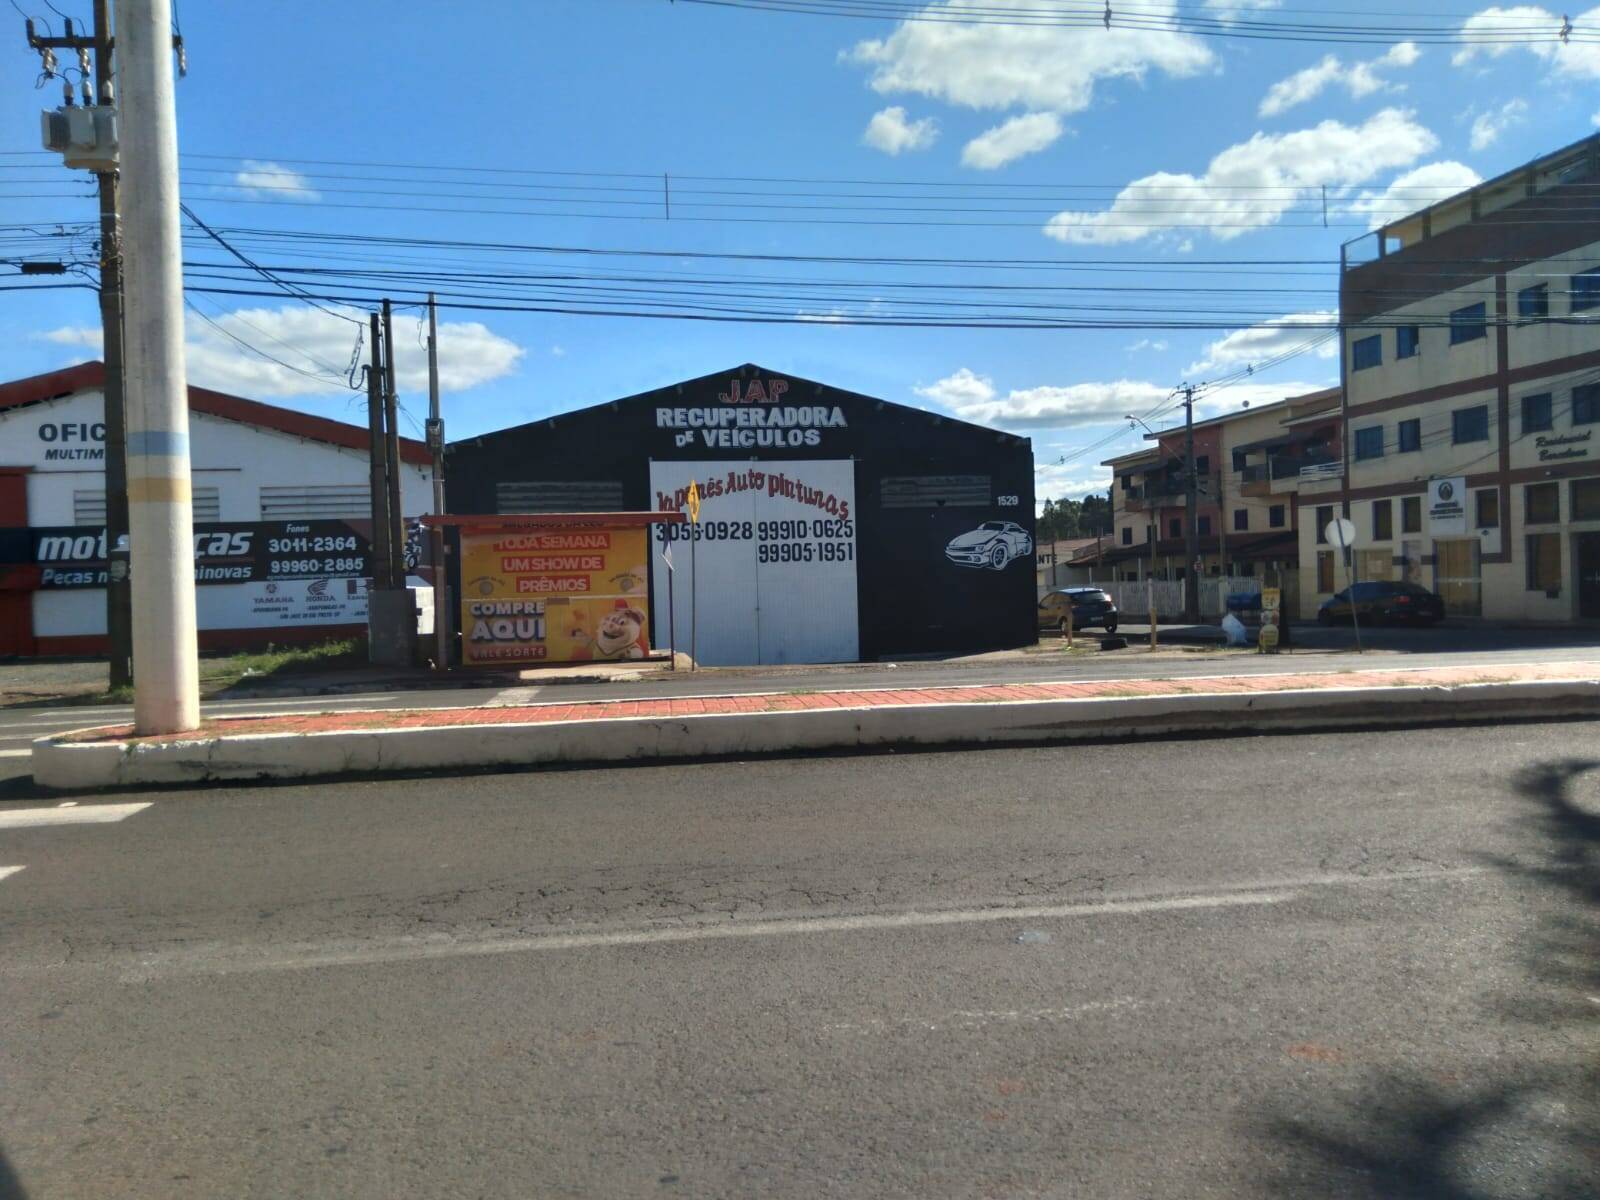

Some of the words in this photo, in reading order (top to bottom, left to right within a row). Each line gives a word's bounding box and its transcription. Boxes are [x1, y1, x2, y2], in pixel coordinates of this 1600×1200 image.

[718, 379, 789, 404] JAP
[656, 406, 848, 428] RECUPERADORA
[38, 422, 107, 442] OFIC
[675, 430, 695, 447] DE
[701, 427, 821, 447] VEÍCULOS
[45, 448, 105, 460] MULTIM
[724, 469, 765, 494] Auto
[496, 535, 541, 549] TODA
[542, 535, 608, 549] SEMANA
[503, 558, 530, 572] UM
[531, 557, 580, 570] SHOW
[581, 557, 601, 569] DE
[42, 568, 94, 585] Peças
[519, 576, 587, 592] PRÊMIOS
[470, 602, 545, 616] COMPRE
[471, 618, 545, 640] AQUI
